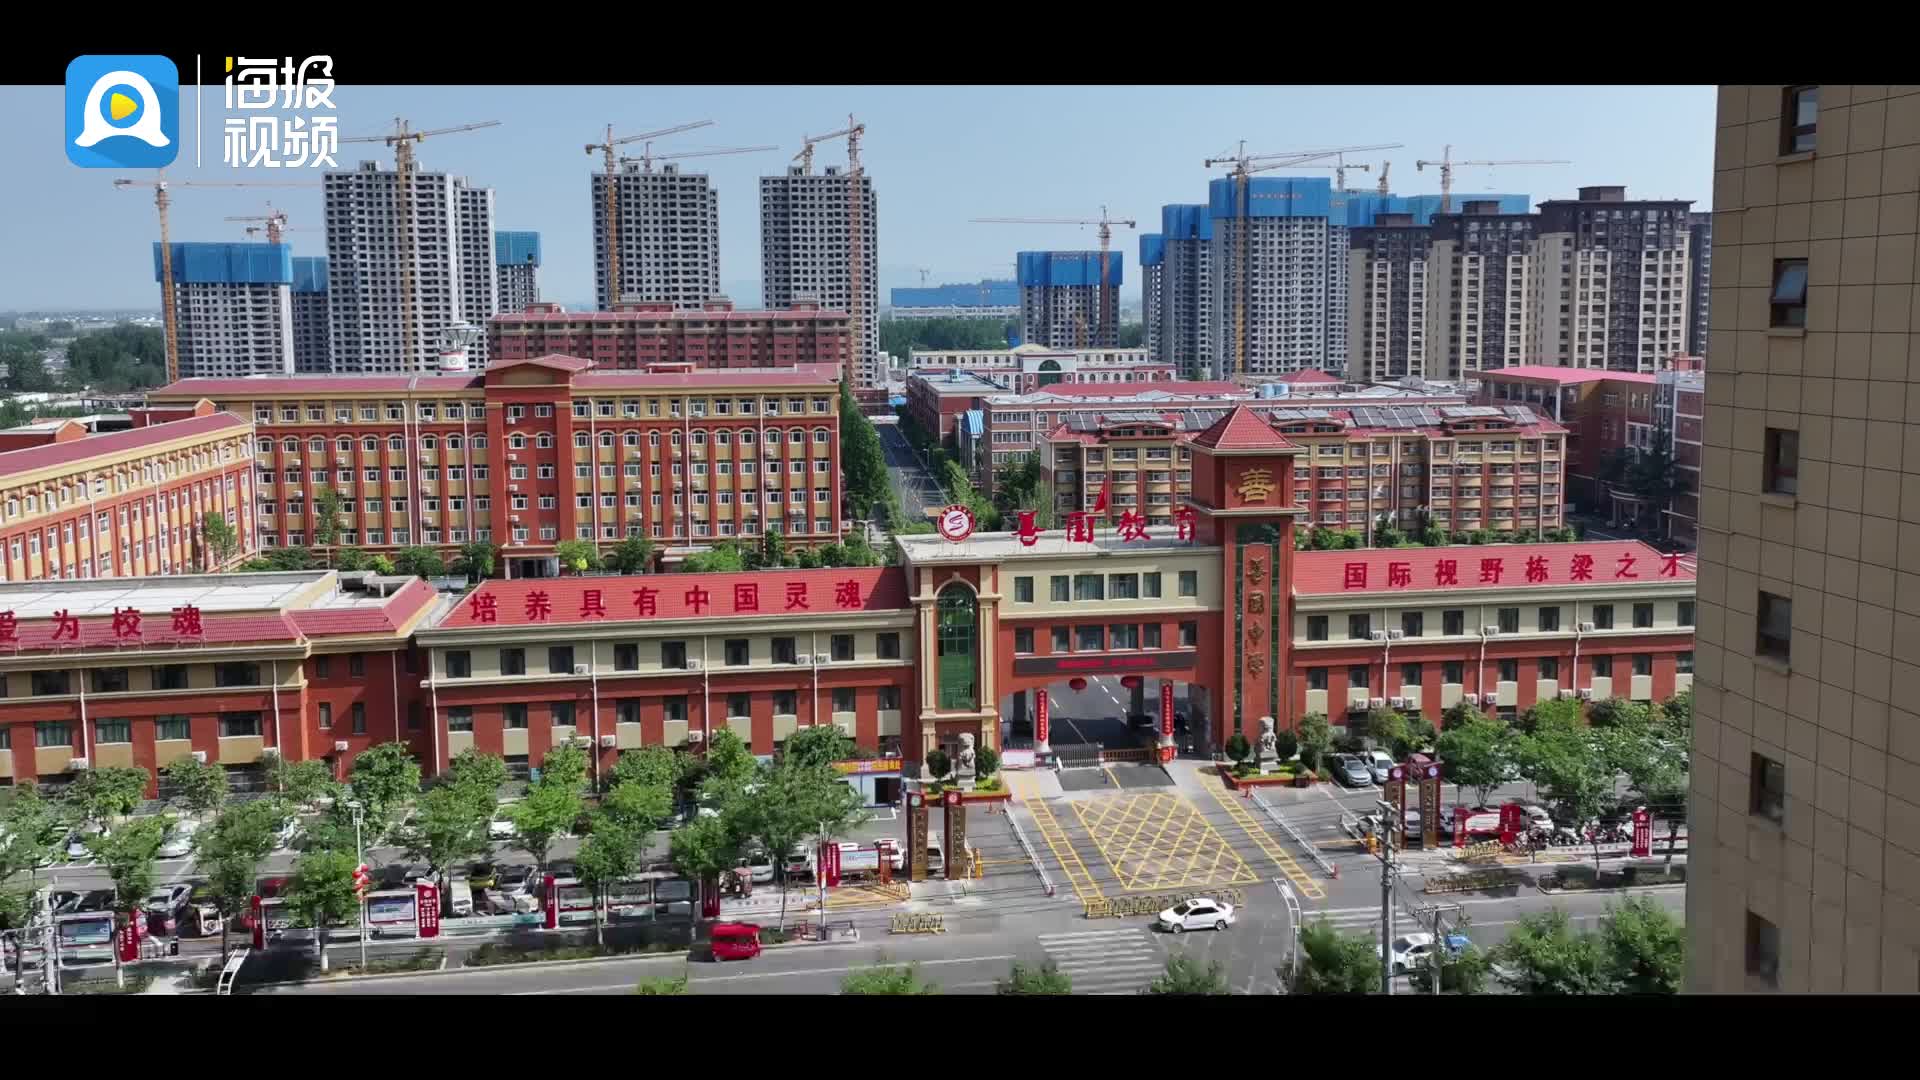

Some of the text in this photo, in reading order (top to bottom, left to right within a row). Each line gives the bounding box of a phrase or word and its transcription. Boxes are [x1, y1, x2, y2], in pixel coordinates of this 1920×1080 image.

[1238, 468, 1276, 502] 善
[1343, 549, 1684, 590] 国际视野栋梁之才
[469, 578, 863, 623] 培养具有中国灵魂
